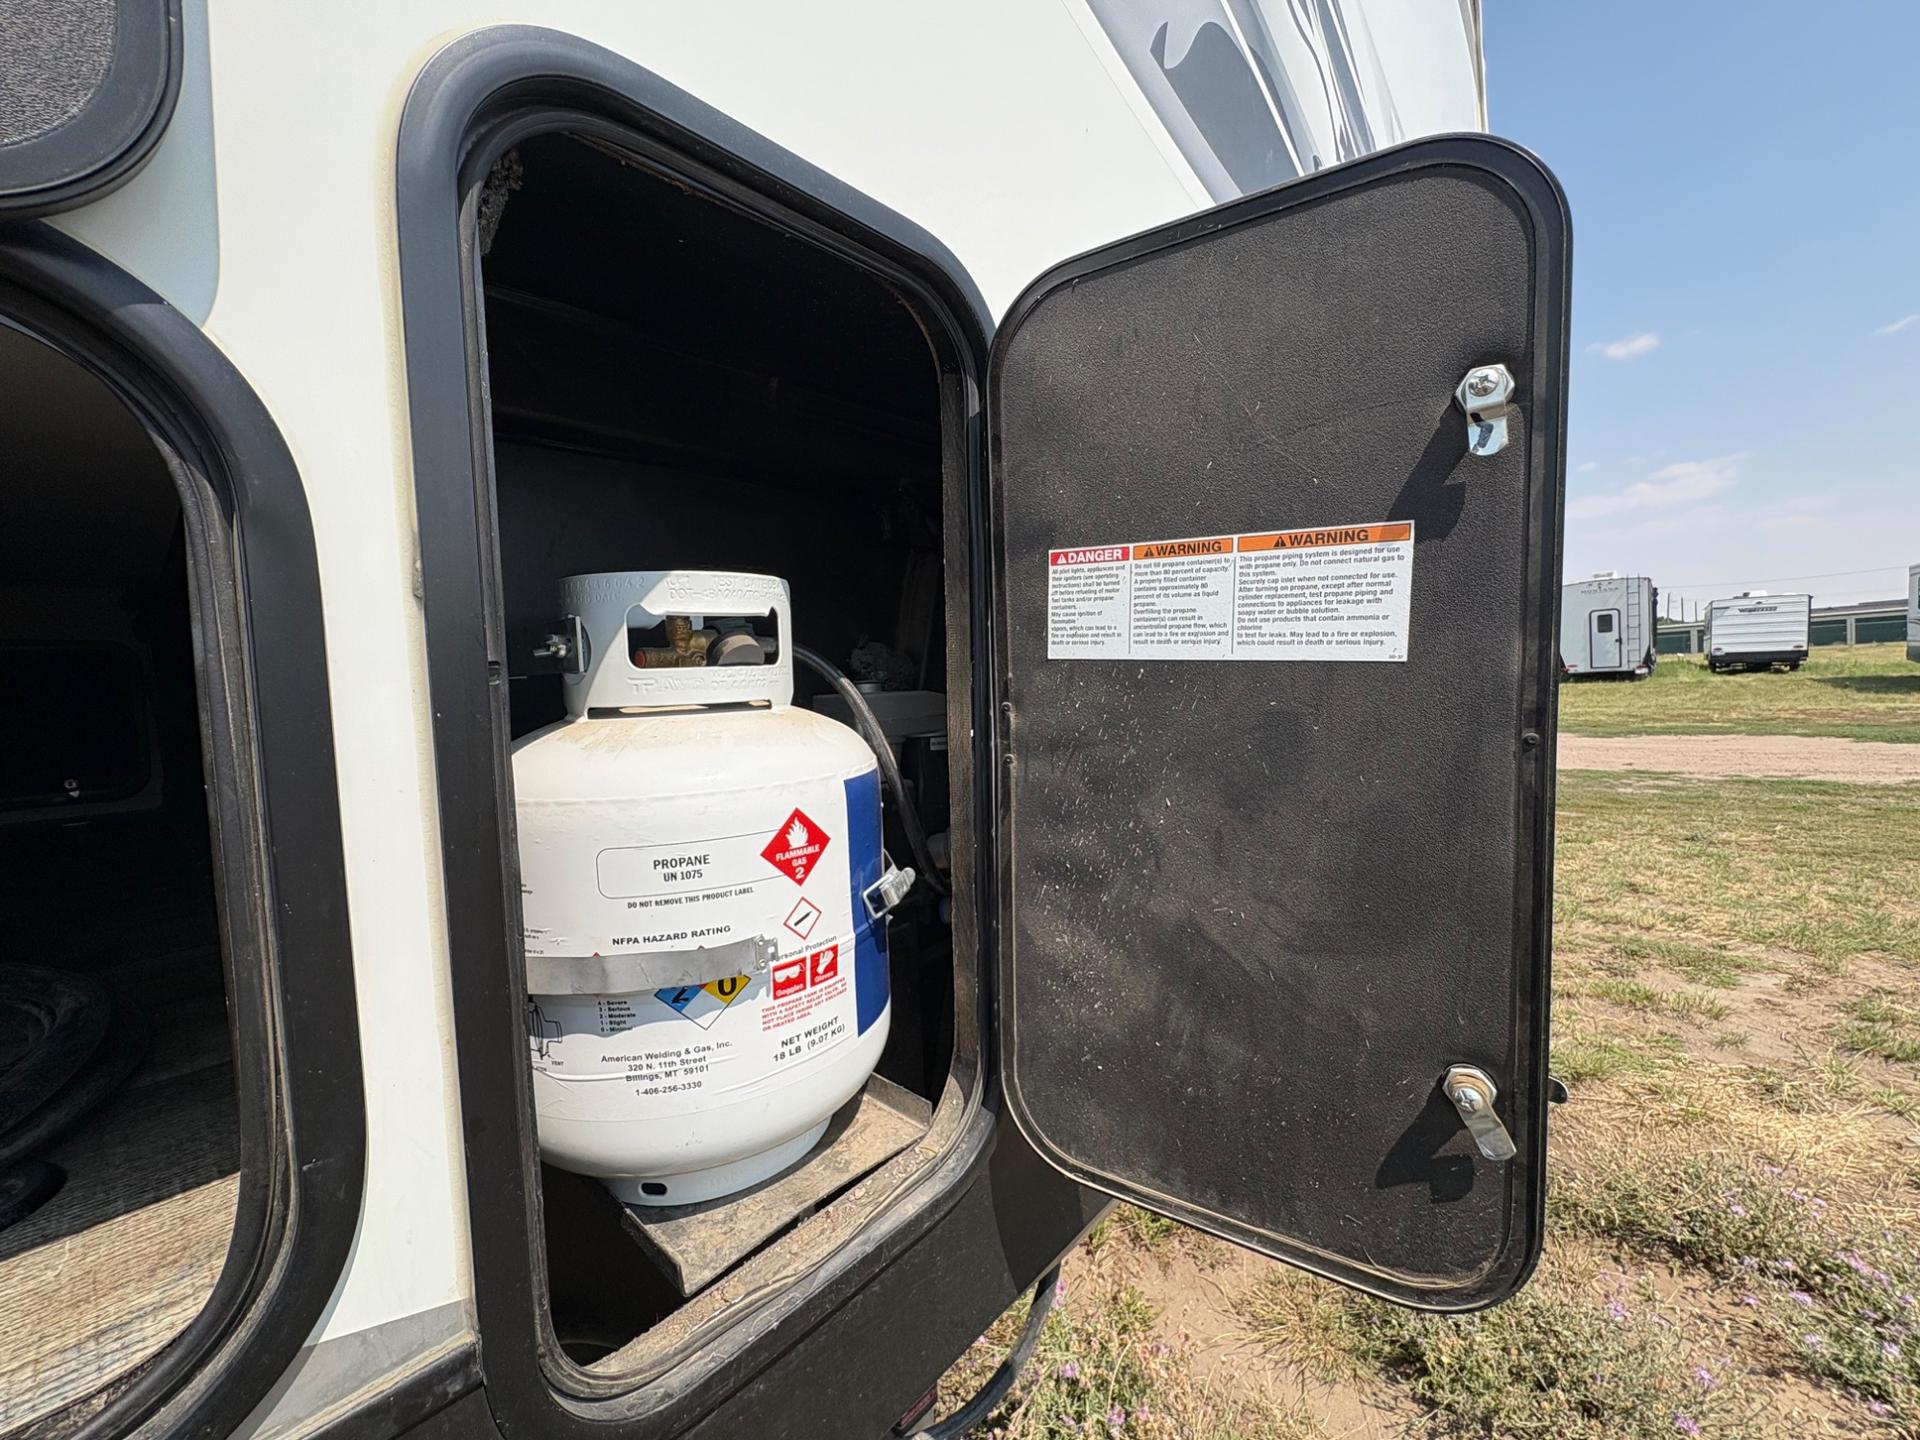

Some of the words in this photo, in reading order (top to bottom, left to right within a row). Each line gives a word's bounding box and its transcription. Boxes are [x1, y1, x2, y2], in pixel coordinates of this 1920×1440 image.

[1289, 530, 1368, 546] WARNING
[1156, 541, 1222, 556] WARNING
[1254, 554, 1280, 562] propane
[1340, 548, 1372, 556] designed
[1068, 549, 1122, 564] DANGER
[776, 844, 820, 862] FLAMMABLE
[653, 854, 710, 870] PROPANE
[792, 856, 808, 867] GAS
[663, 872, 677, 882] UN
[680, 869, 702, 880] 1075
[795, 866, 805, 880] 2
[640, 900, 652, 908] NOT
[655, 897, 682, 907] REMOVE
[685, 895, 700, 904] THIS
[702, 890, 733, 902] PRODUCT
[734, 886, 754, 896] LABEL
[612, 936, 640, 946] NFPA
[643, 931, 688, 944] HAZARD
[692, 924, 731, 938] RATING
[805, 936, 837, 951] Protection
[814, 971, 835, 983] Gloves
[776, 984, 804, 997] Goggles
[777, 997, 802, 1008] PROPANE
[784, 1002, 804, 1012] SAFETY
[781, 1033, 801, 1048] NET
[804, 1016, 838, 1039] WEIGHT
[600, 1054, 642, 1063] American
[645, 1050, 682, 1060] Welding
[694, 1044, 714, 1054] Gas,
[716, 1041, 733, 1050] Inc.
[774, 1051, 786, 1062] 18
[789, 1045, 802, 1056] LB
[808, 1032, 828, 1051] (9.07
[628, 1064, 644, 1072] 320
[646, 1062, 655, 1070] N.
[658, 1060, 676, 1069] 11th
[680, 1056, 706, 1066] Street
[626, 1072, 662, 1082] Billings,
[664, 1069, 678, 1078] MT
[684, 1064, 710, 1076] 59101
[635, 1080, 702, 1096] 1-406-256-3330
